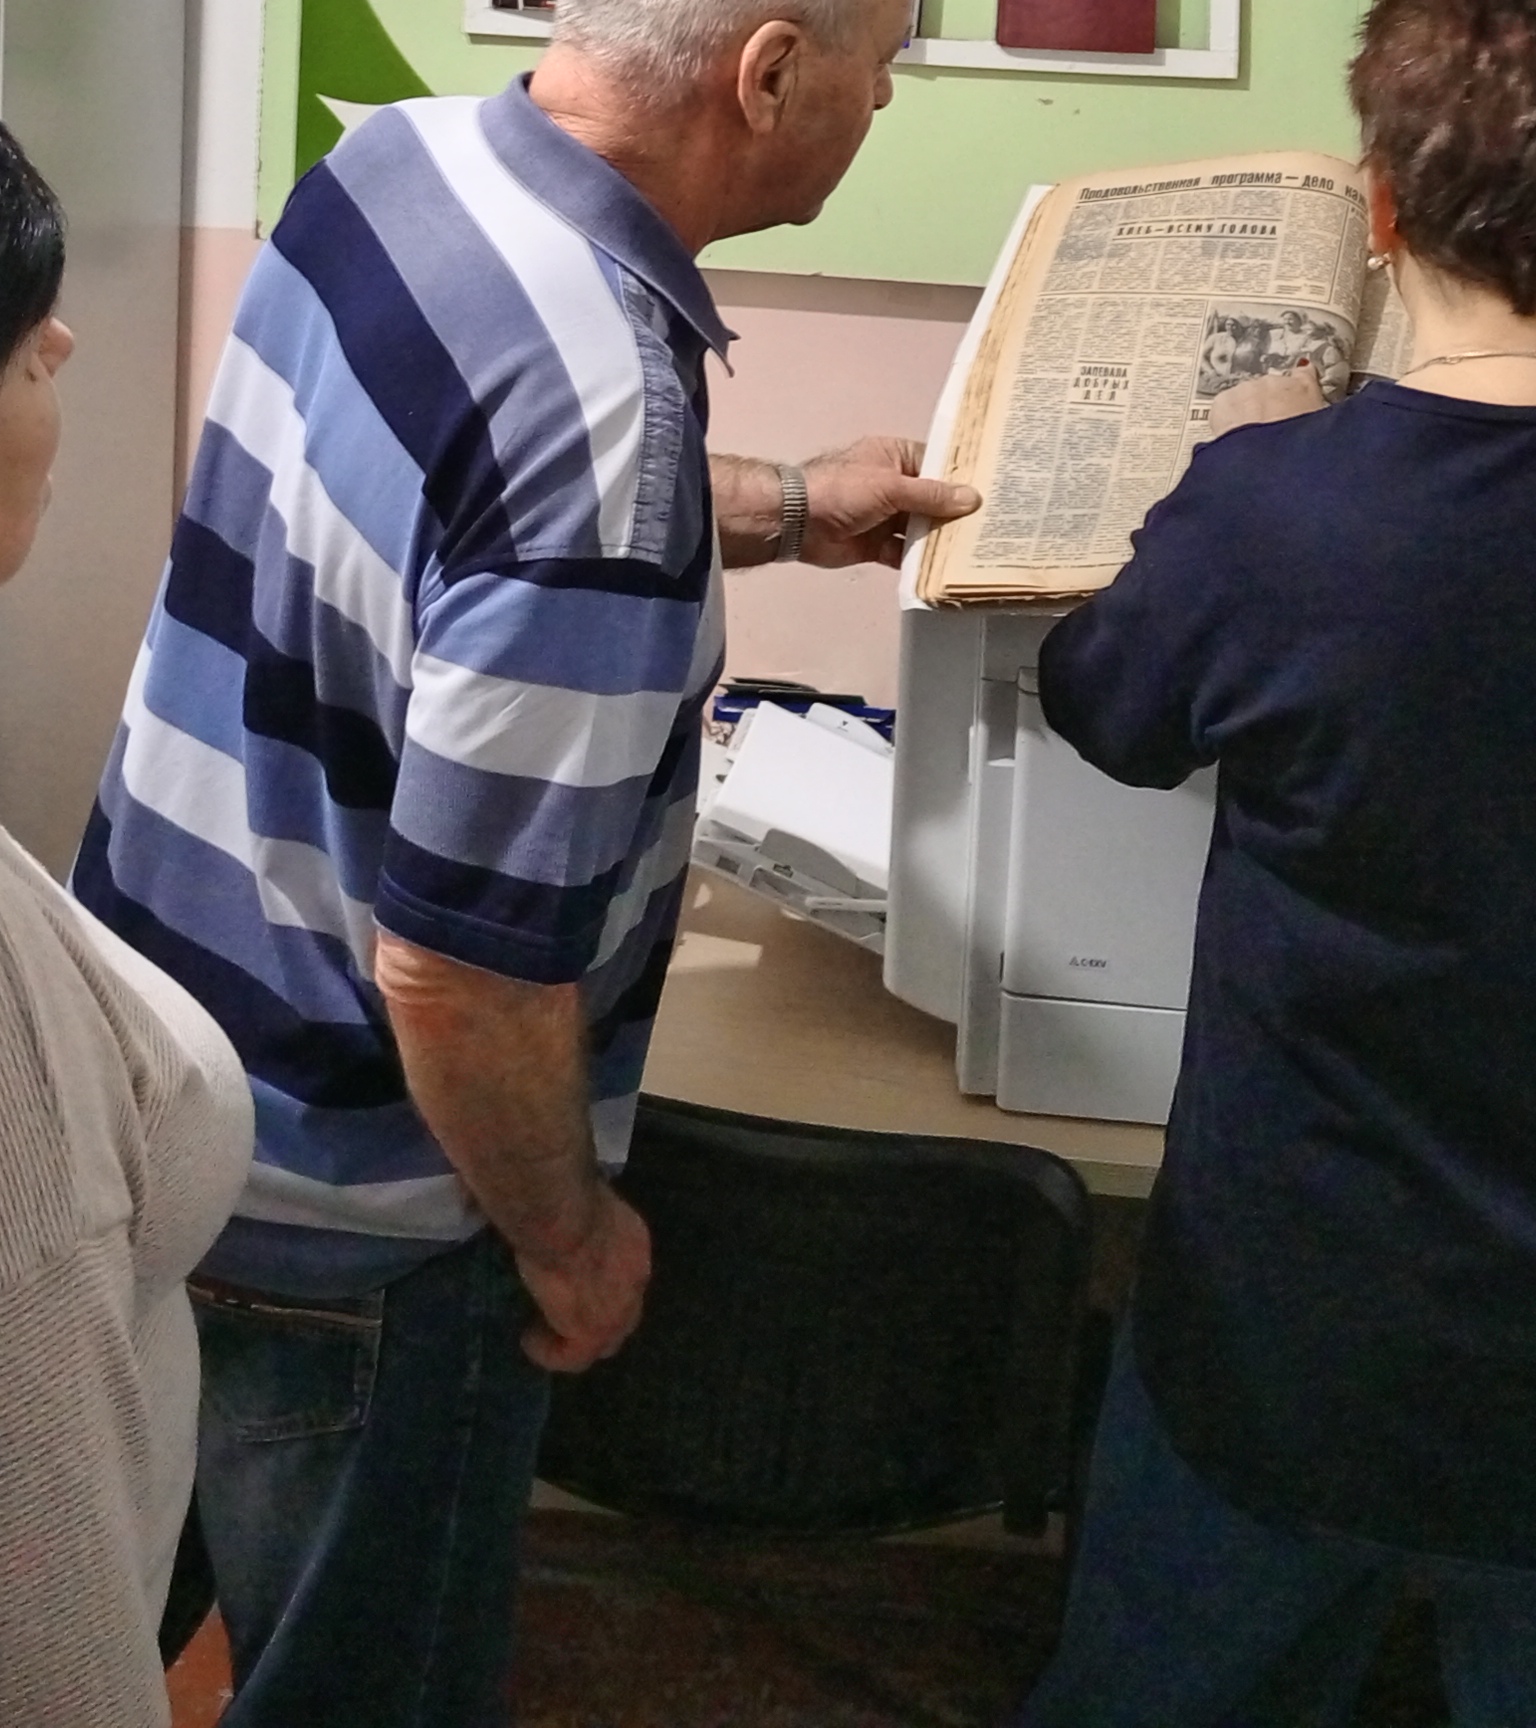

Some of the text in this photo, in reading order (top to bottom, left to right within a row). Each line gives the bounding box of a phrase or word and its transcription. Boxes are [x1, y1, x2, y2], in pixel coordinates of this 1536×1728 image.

[1079, 176, 1201, 200] Продовольственная
[1212, 173, 1282, 186] программа
[1302, 175, 1334, 191] дело
[1117, 224, 1277, 236] ХЛЕБ ВСЕМУ ГОЛОВА
[1080, 366, 1128, 378] ЗАПЕВАЛА
[1073, 377, 1130, 390] ДОБРЫХ
